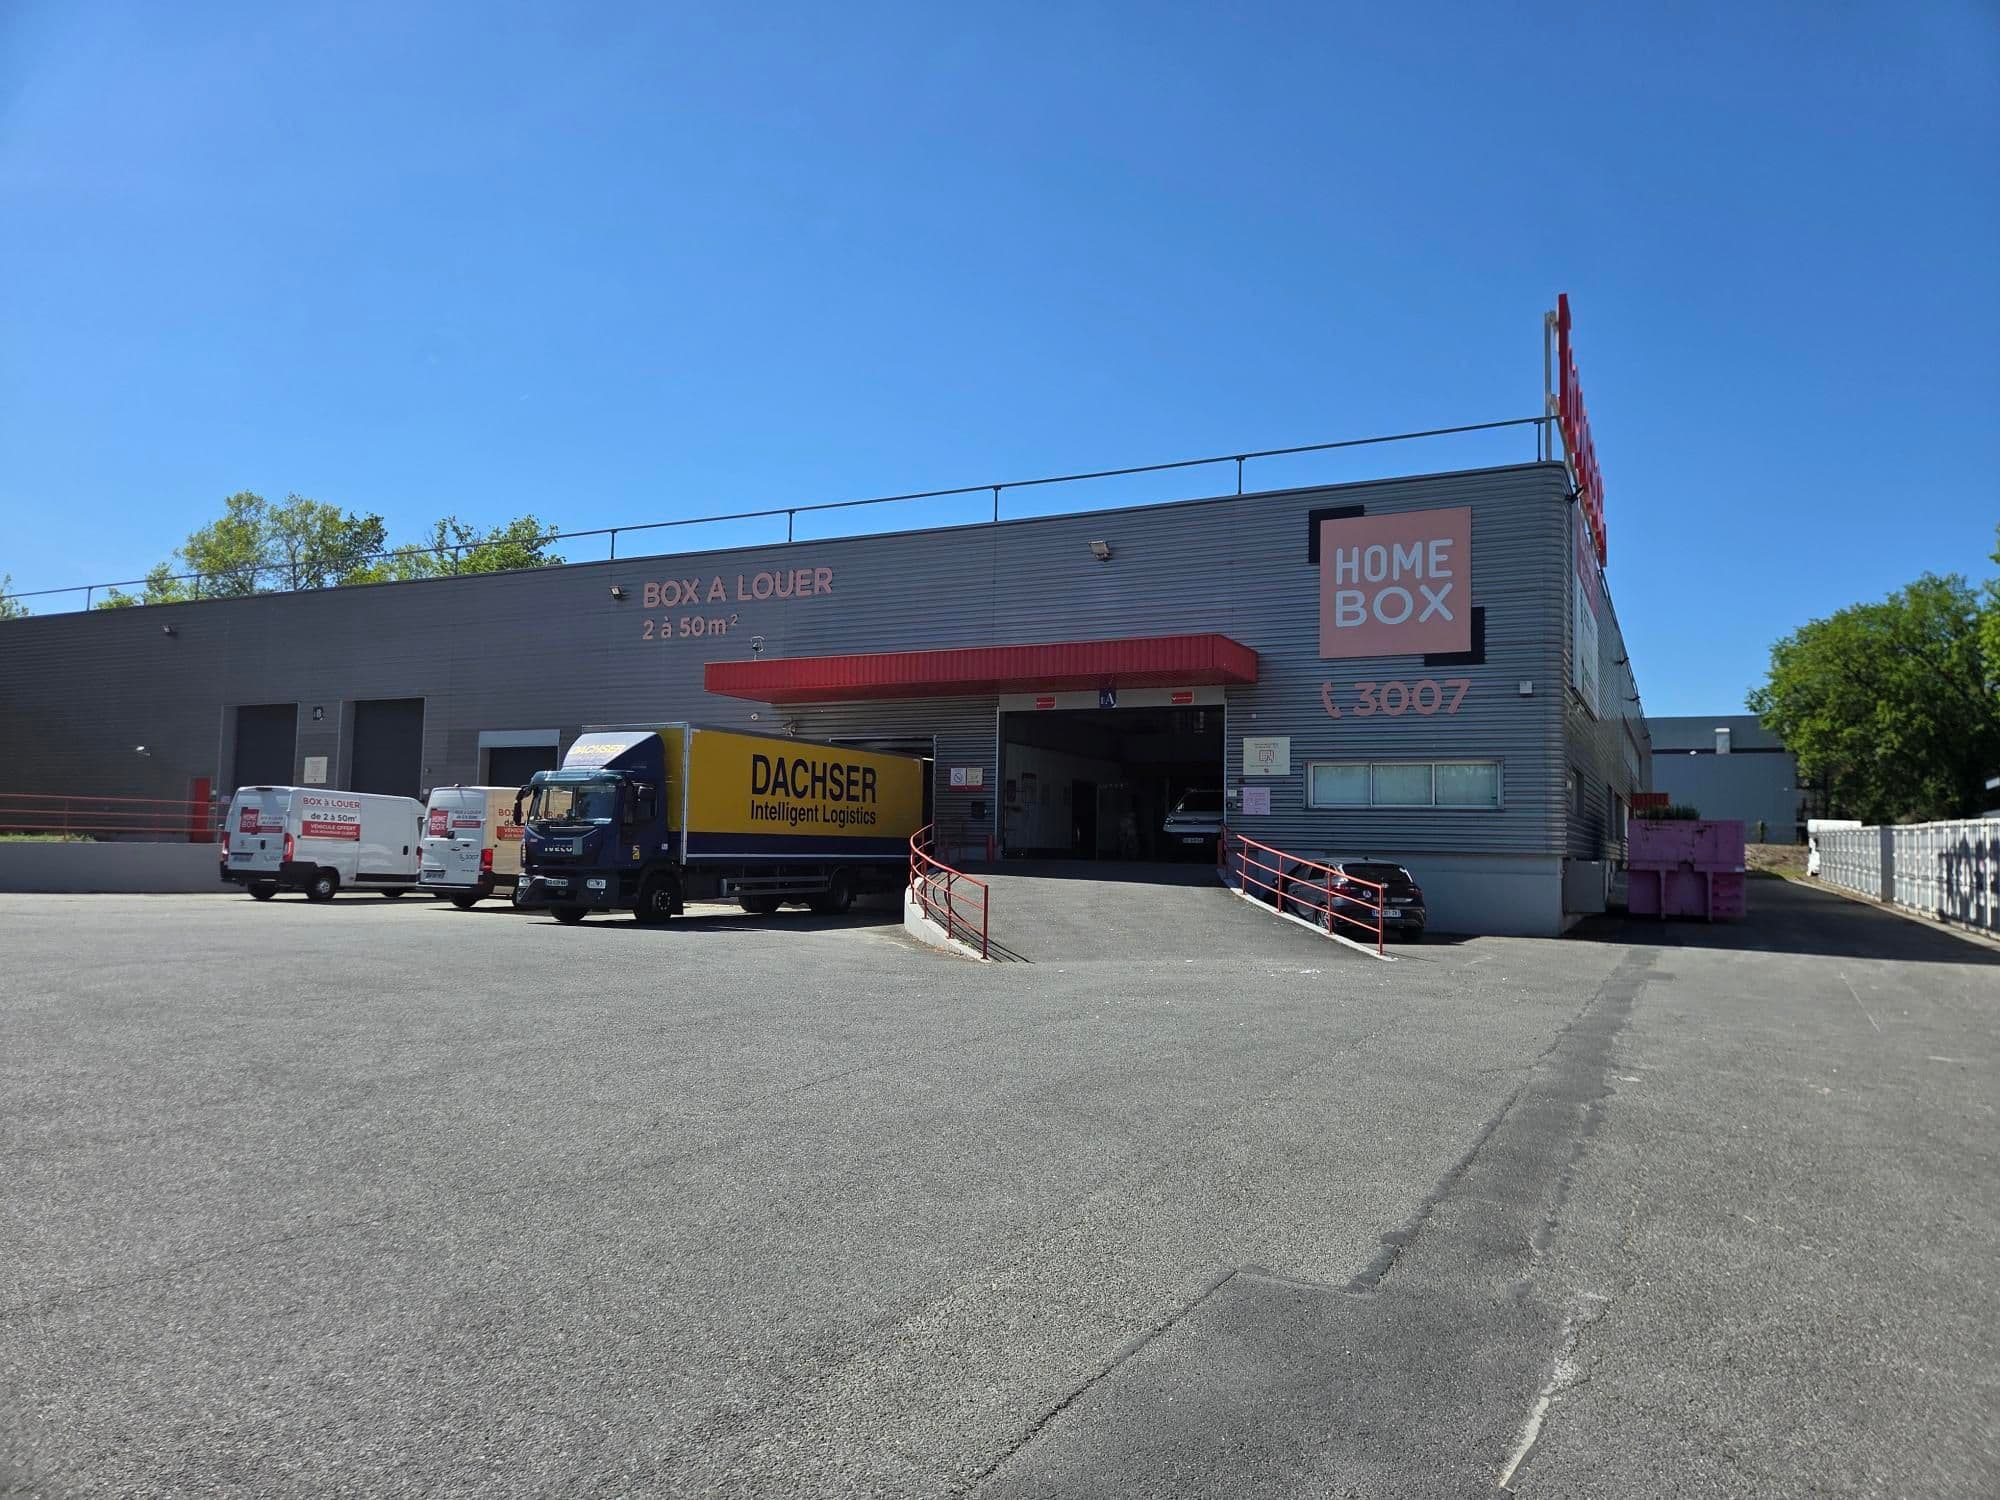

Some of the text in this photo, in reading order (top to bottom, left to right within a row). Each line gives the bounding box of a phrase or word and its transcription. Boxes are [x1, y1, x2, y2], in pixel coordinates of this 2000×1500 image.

[1335, 538, 1454, 585] HOME
[642, 567, 833, 608] BOX A LOUER
[1335, 583, 1454, 628] BOX
[642, 619, 655, 639] 2
[661, 616, 672, 639] à
[1353, 678, 1471, 717] 3007
[573, 744, 626, 755] DACHSER
[751, 753, 877, 803] DACHSER
[303, 797, 322, 806] BOX
[331, 800, 360, 808] LOUER
[751, 799, 876, 828] Intelligent Logistics
[241, 820, 257, 828] BOX
[310, 812, 321, 820] de
[431, 822, 446, 831] BOX
[544, 844, 573, 853] IVECO
